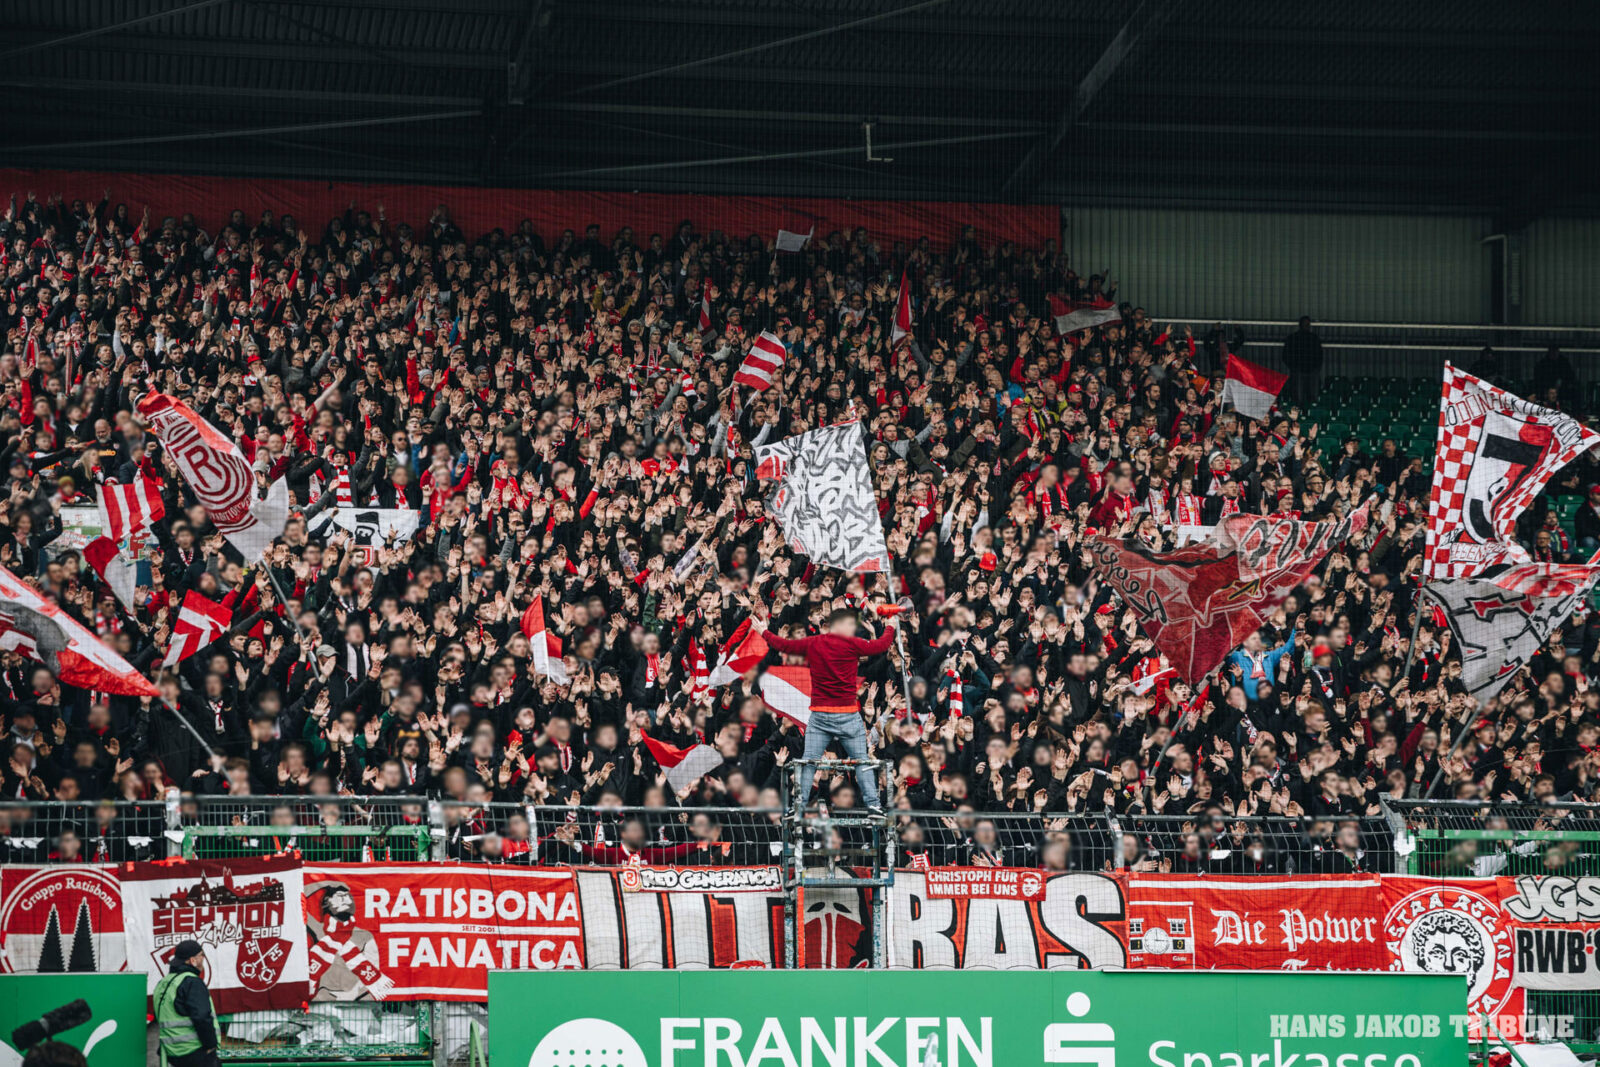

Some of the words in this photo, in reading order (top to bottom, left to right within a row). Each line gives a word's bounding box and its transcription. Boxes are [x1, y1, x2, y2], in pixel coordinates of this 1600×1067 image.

[640, 868, 679, 889] RED
[679, 867, 781, 890] GENERATION
[928, 870, 992, 883] CHRISTOPH
[995, 868, 1018, 883] FÜR
[929, 883, 968, 896] IMMER
[971, 883, 990, 896] BEI
[993, 883, 1018, 896] UNS
[20, 879, 63, 912] Gruppo
[65, 877, 118, 911] Ratisbona
[364, 887, 579, 922] RATISBONA
[252, 926, 281, 939] 2019
[1210, 908, 1267, 947] Die
[1279, 908, 1378, 952] Power
[388, 936, 583, 970] FANATICA
[660, 1016, 993, 1067] FRANKEN
